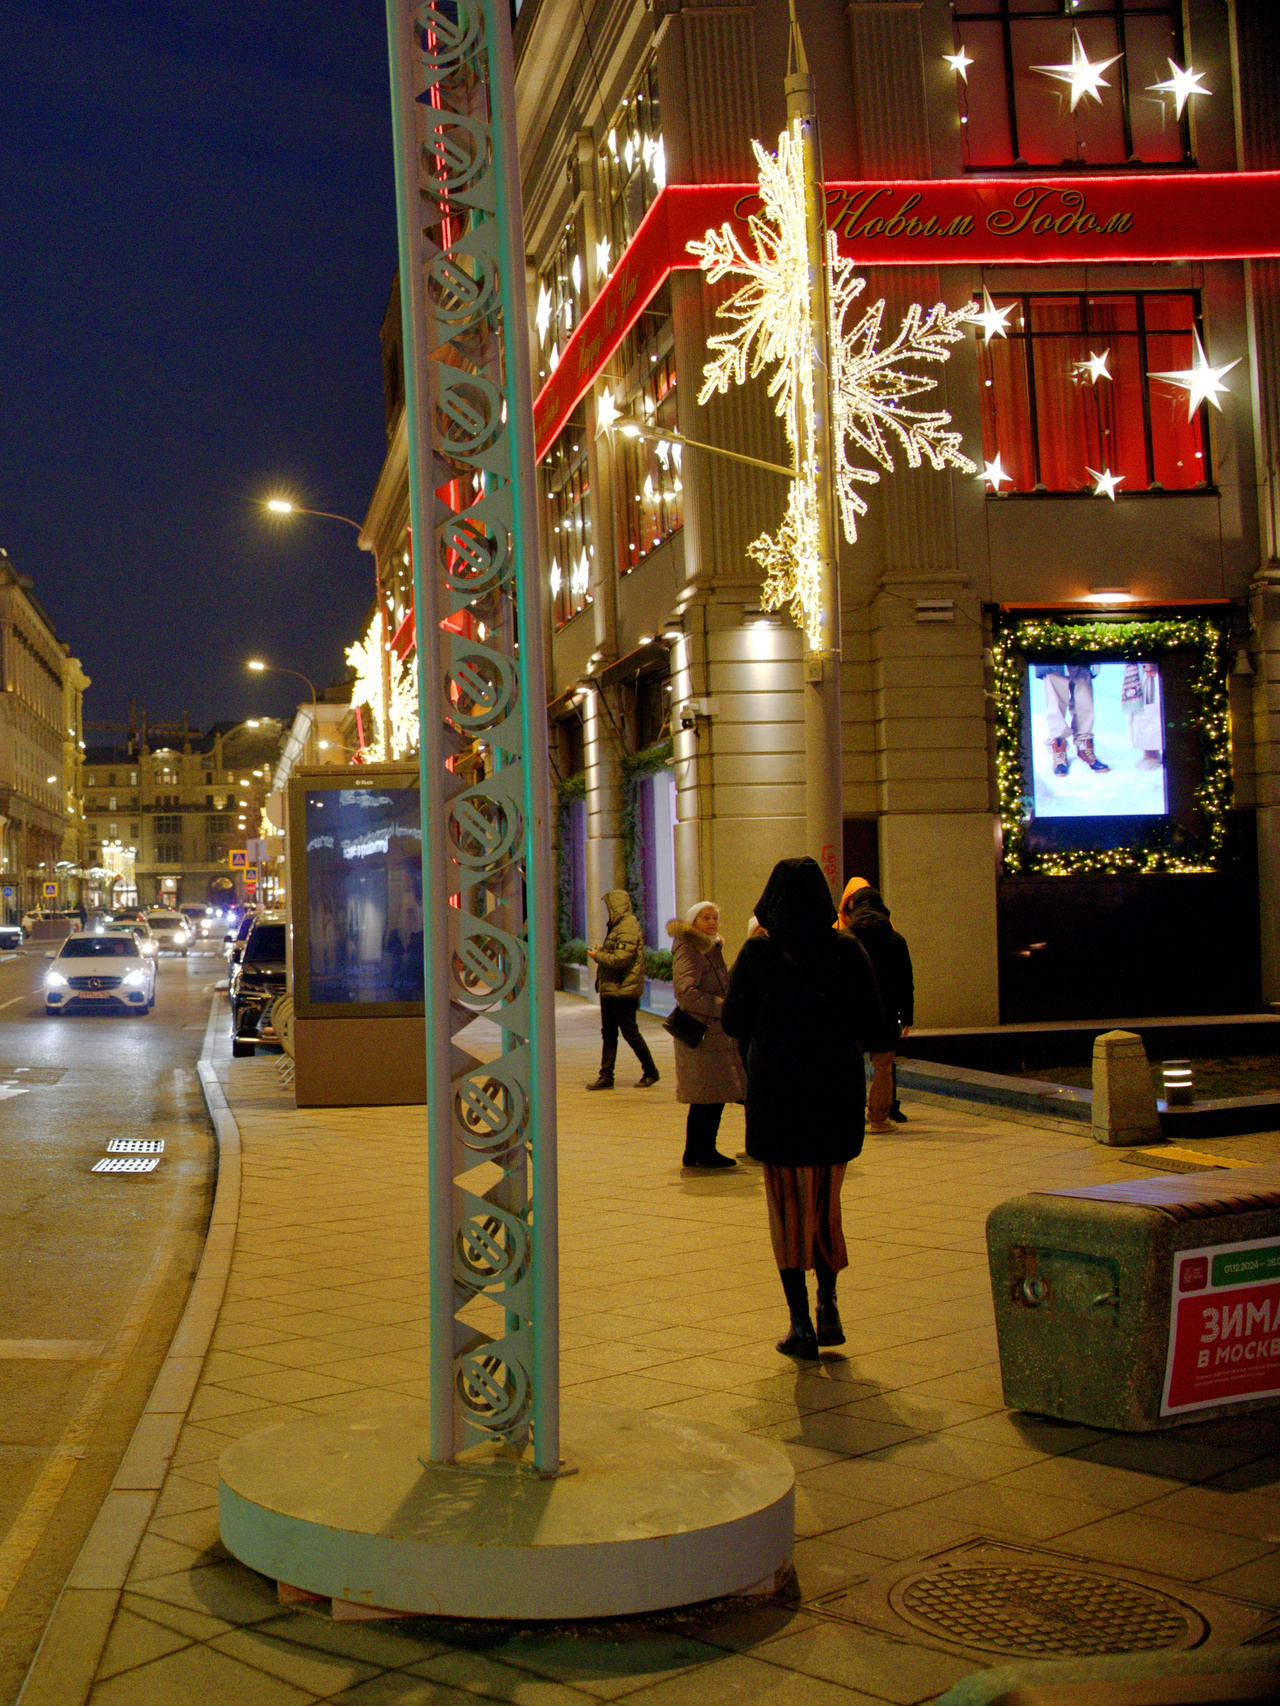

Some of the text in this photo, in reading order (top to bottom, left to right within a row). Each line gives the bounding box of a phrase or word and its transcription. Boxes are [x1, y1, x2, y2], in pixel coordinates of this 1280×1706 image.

[820, 188, 979, 239] Новым
[986, 185, 1135, 236] Годом
[1198, 1349, 1210, 1369] В
